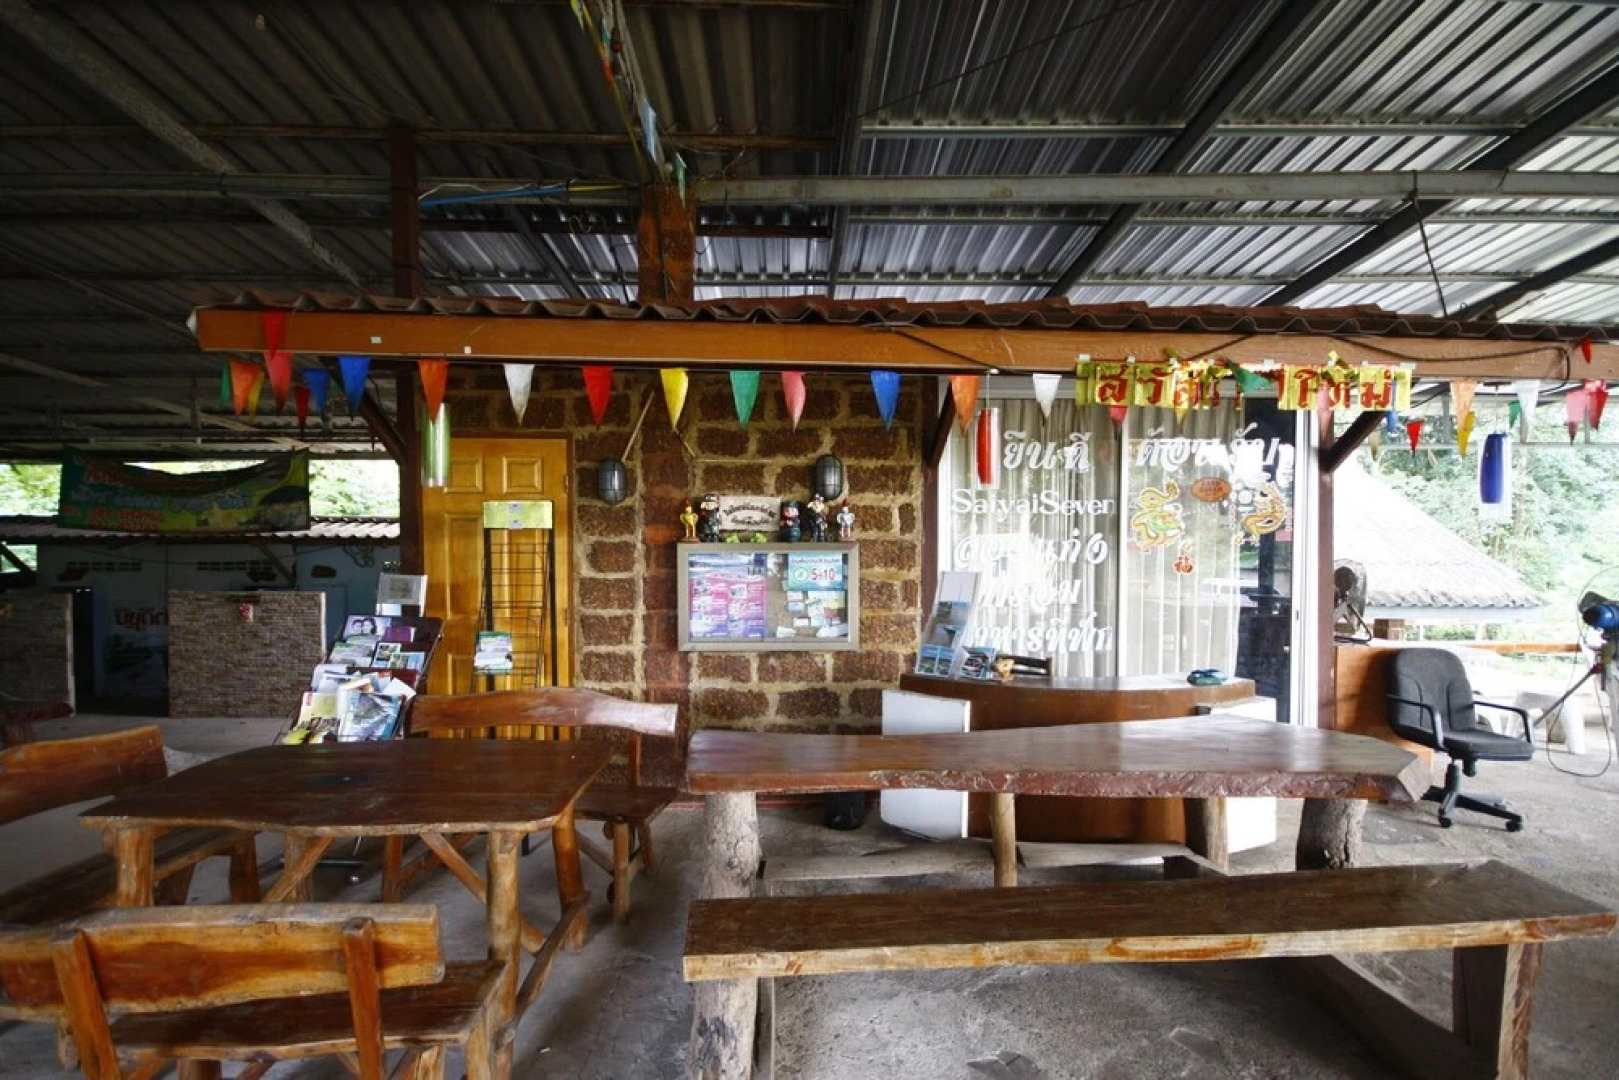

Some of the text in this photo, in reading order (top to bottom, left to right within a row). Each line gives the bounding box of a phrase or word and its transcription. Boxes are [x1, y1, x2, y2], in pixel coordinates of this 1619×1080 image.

[977, 574, 1082, 613] พรอม
[973, 607, 1113, 653] าหารที่พัก
